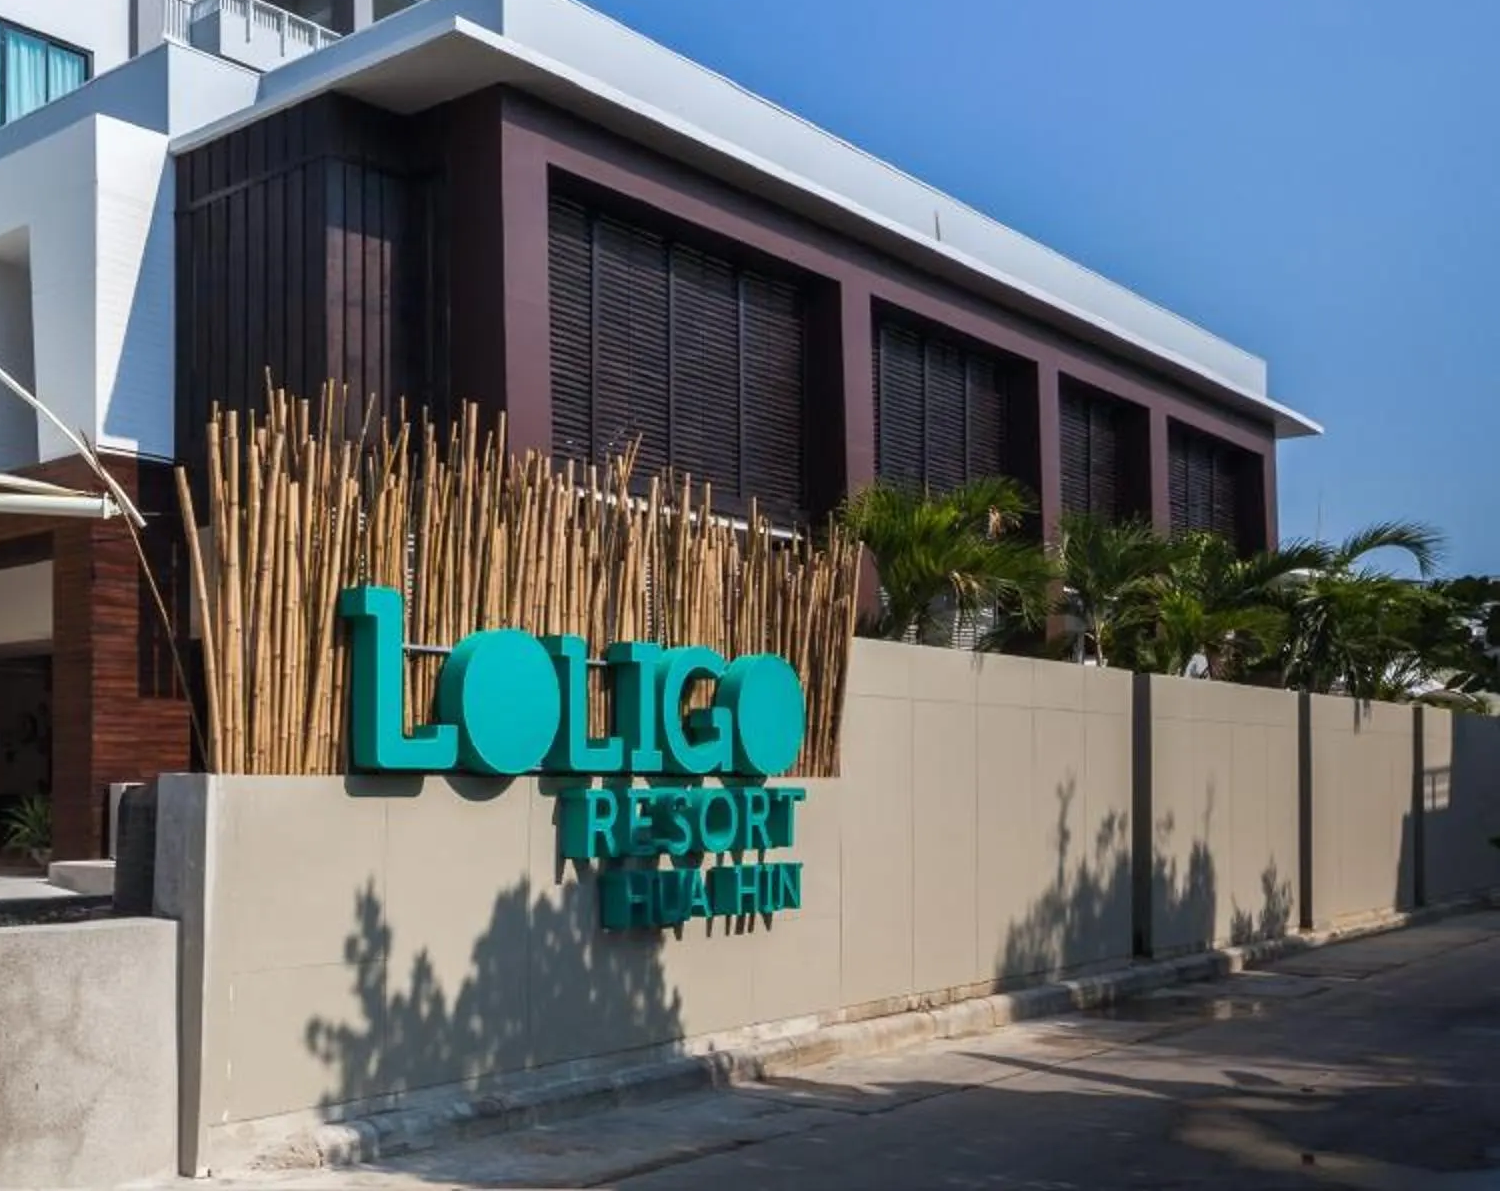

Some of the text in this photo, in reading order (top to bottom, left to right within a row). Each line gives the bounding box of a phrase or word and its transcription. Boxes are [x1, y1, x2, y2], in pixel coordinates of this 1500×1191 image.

[344, 584, 806, 776] LOLIGO
[576, 786, 806, 859] RESORT
[614, 862, 804, 924] HUA HIN
